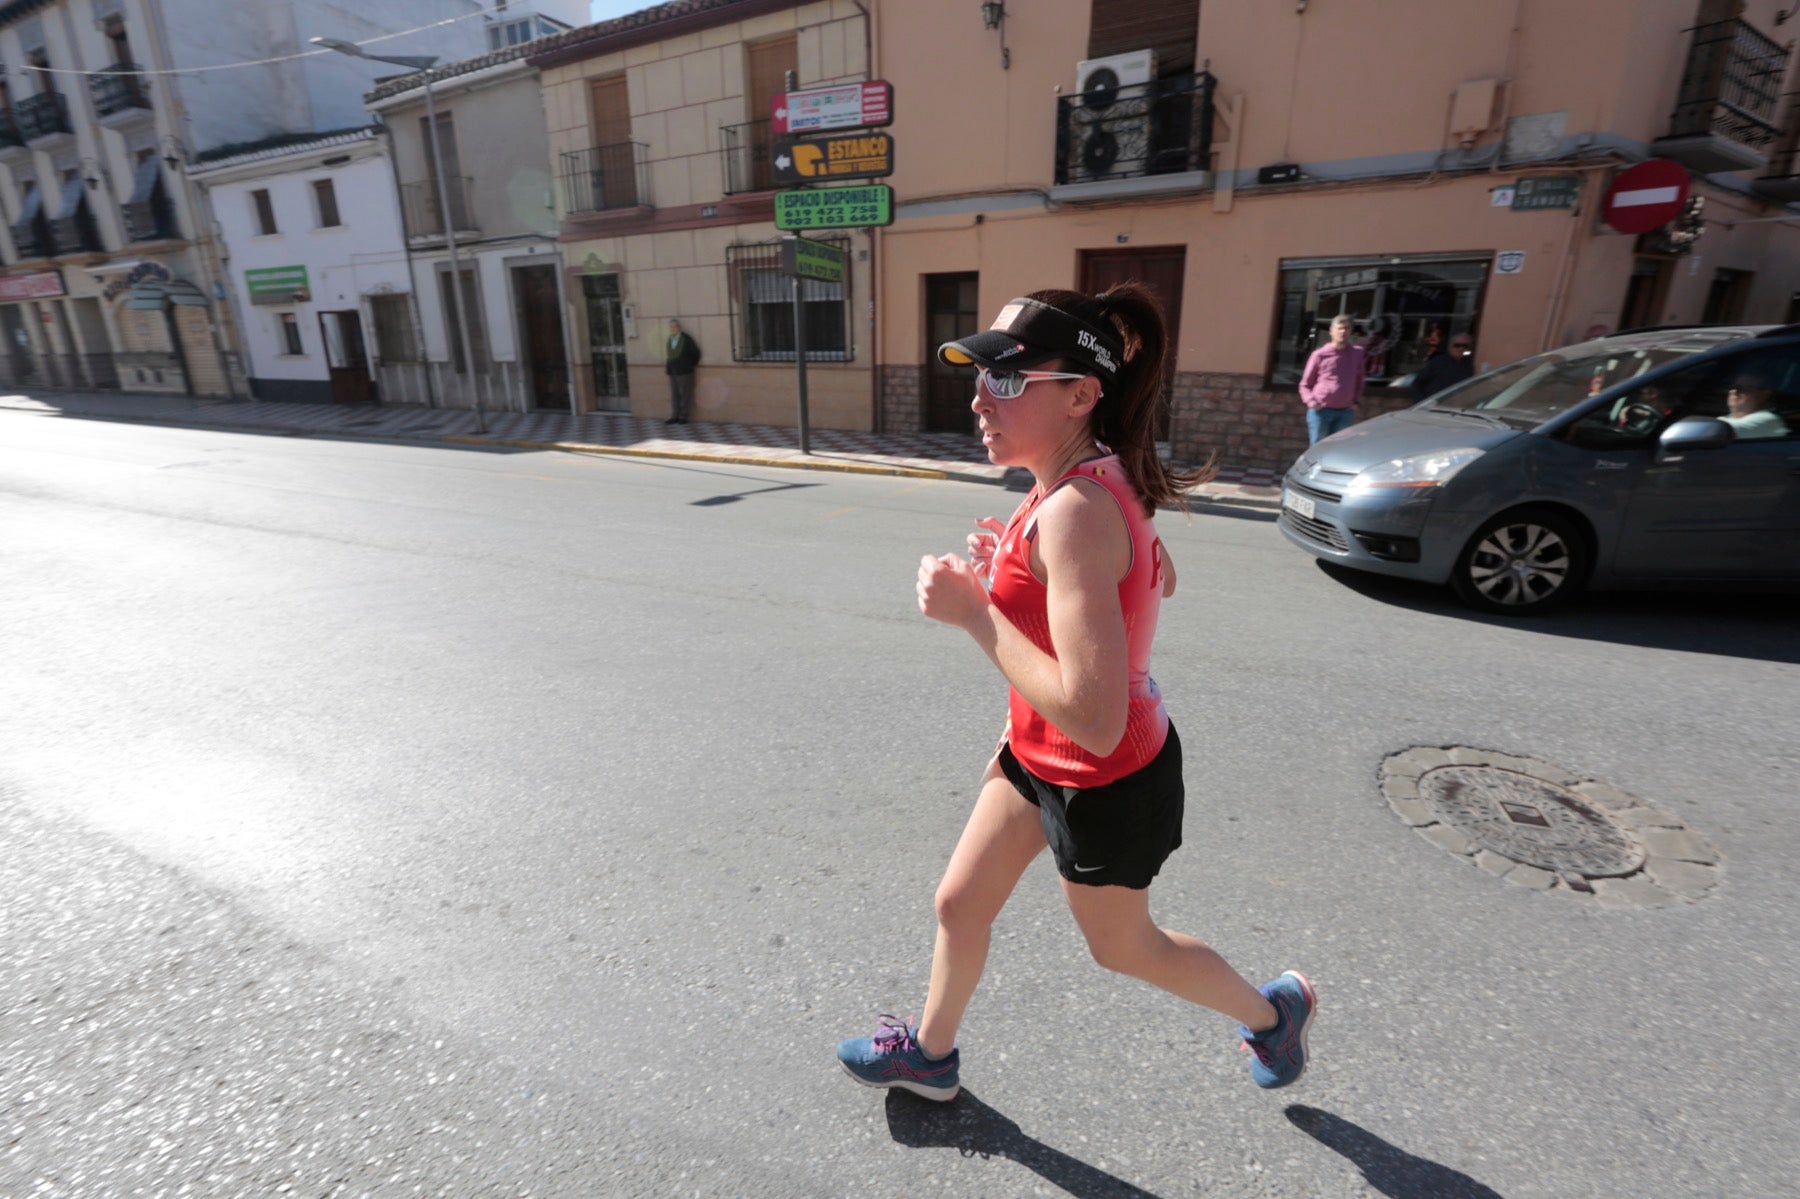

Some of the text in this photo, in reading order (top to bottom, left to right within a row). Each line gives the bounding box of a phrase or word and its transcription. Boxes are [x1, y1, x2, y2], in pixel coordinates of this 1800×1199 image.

[828, 136, 887, 160] ESTANCO
[784, 193, 820, 208] ESPACIO
[823, 189, 879, 206] DISPONIBLE
[784, 205, 878, 218] 619 472 758
[784, 214, 879, 226] 902 103 669
[1077, 329, 1112, 361] 15X WORLD
